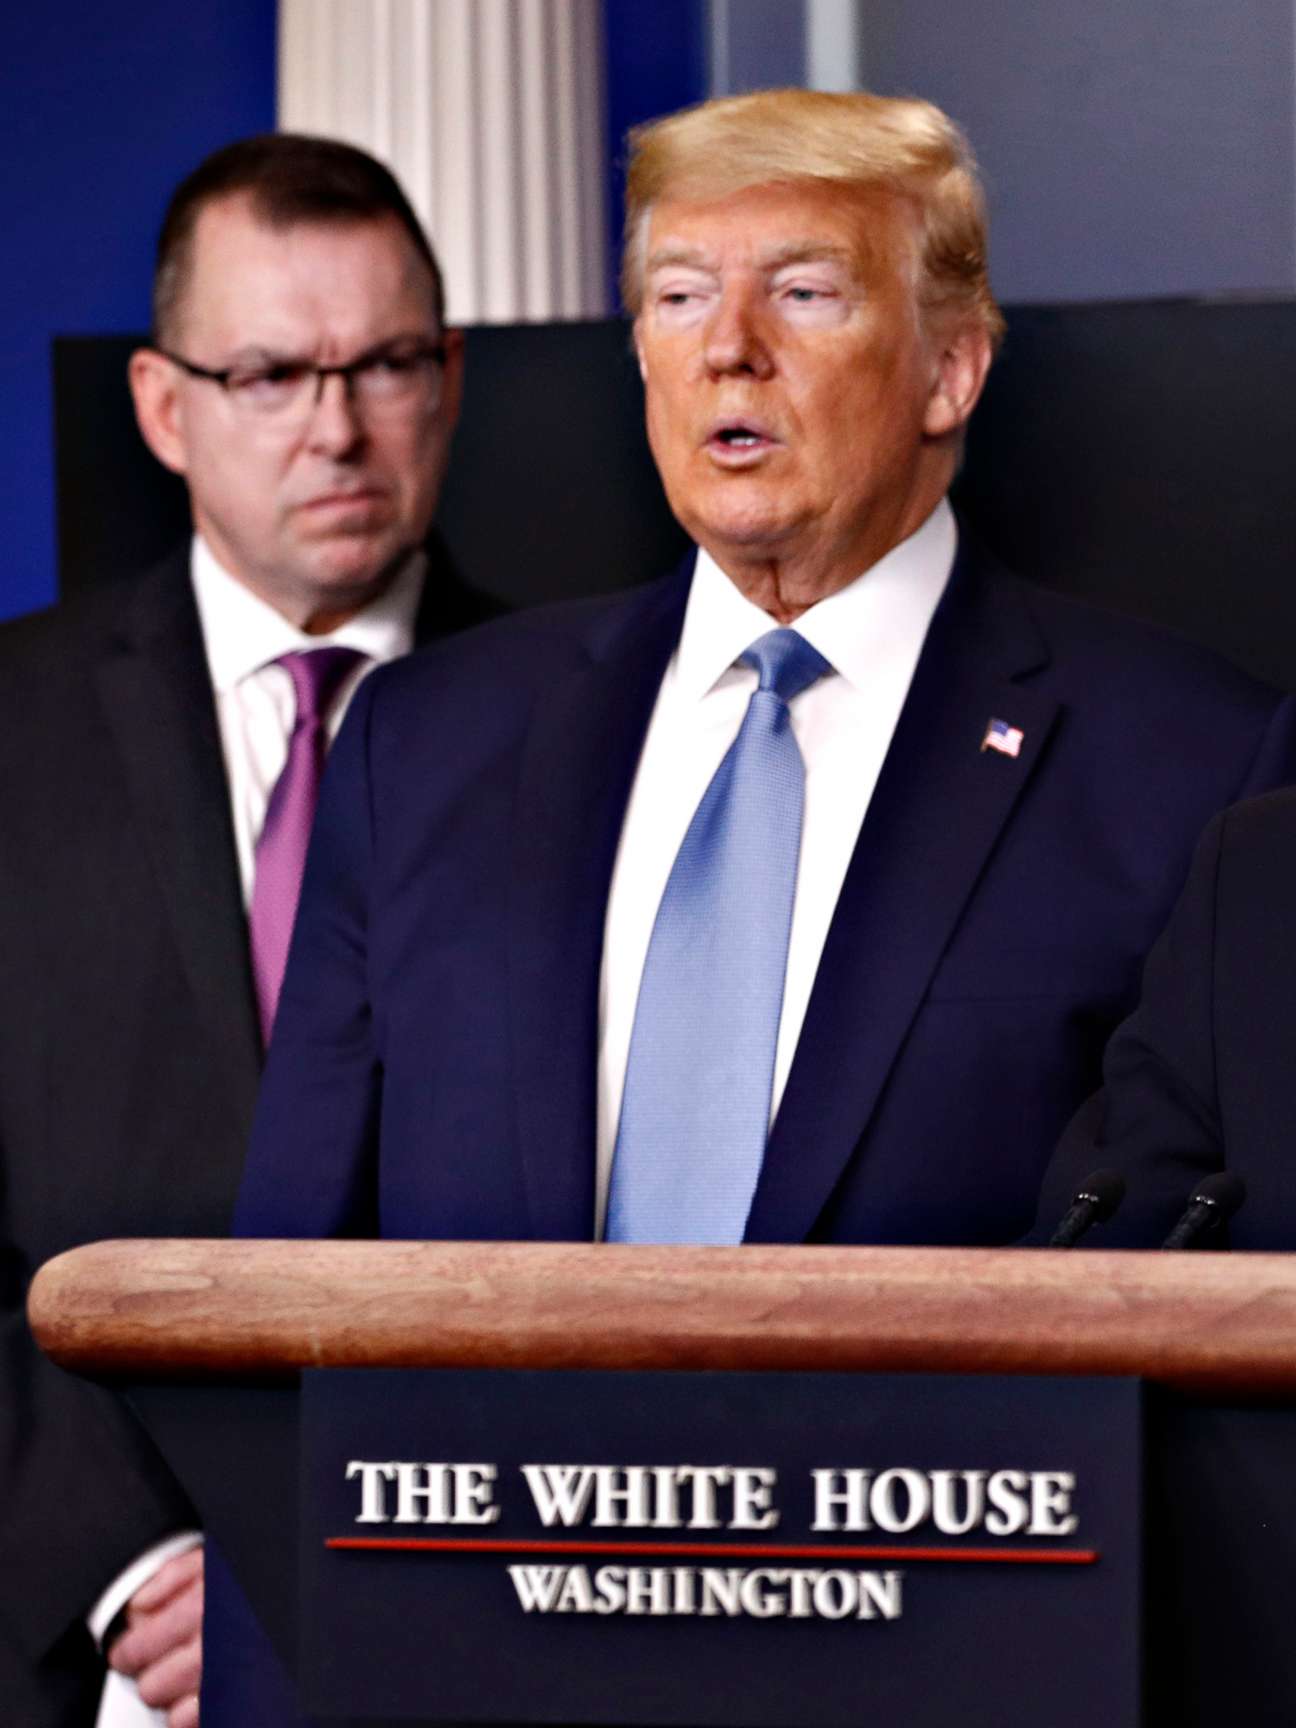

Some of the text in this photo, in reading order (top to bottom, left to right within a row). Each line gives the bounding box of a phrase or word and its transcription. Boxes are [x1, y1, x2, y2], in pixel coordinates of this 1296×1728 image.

[346, 1461, 1080, 1537] THE WHITE HOUSE
[506, 1564, 904, 1620] WASHINGTON
